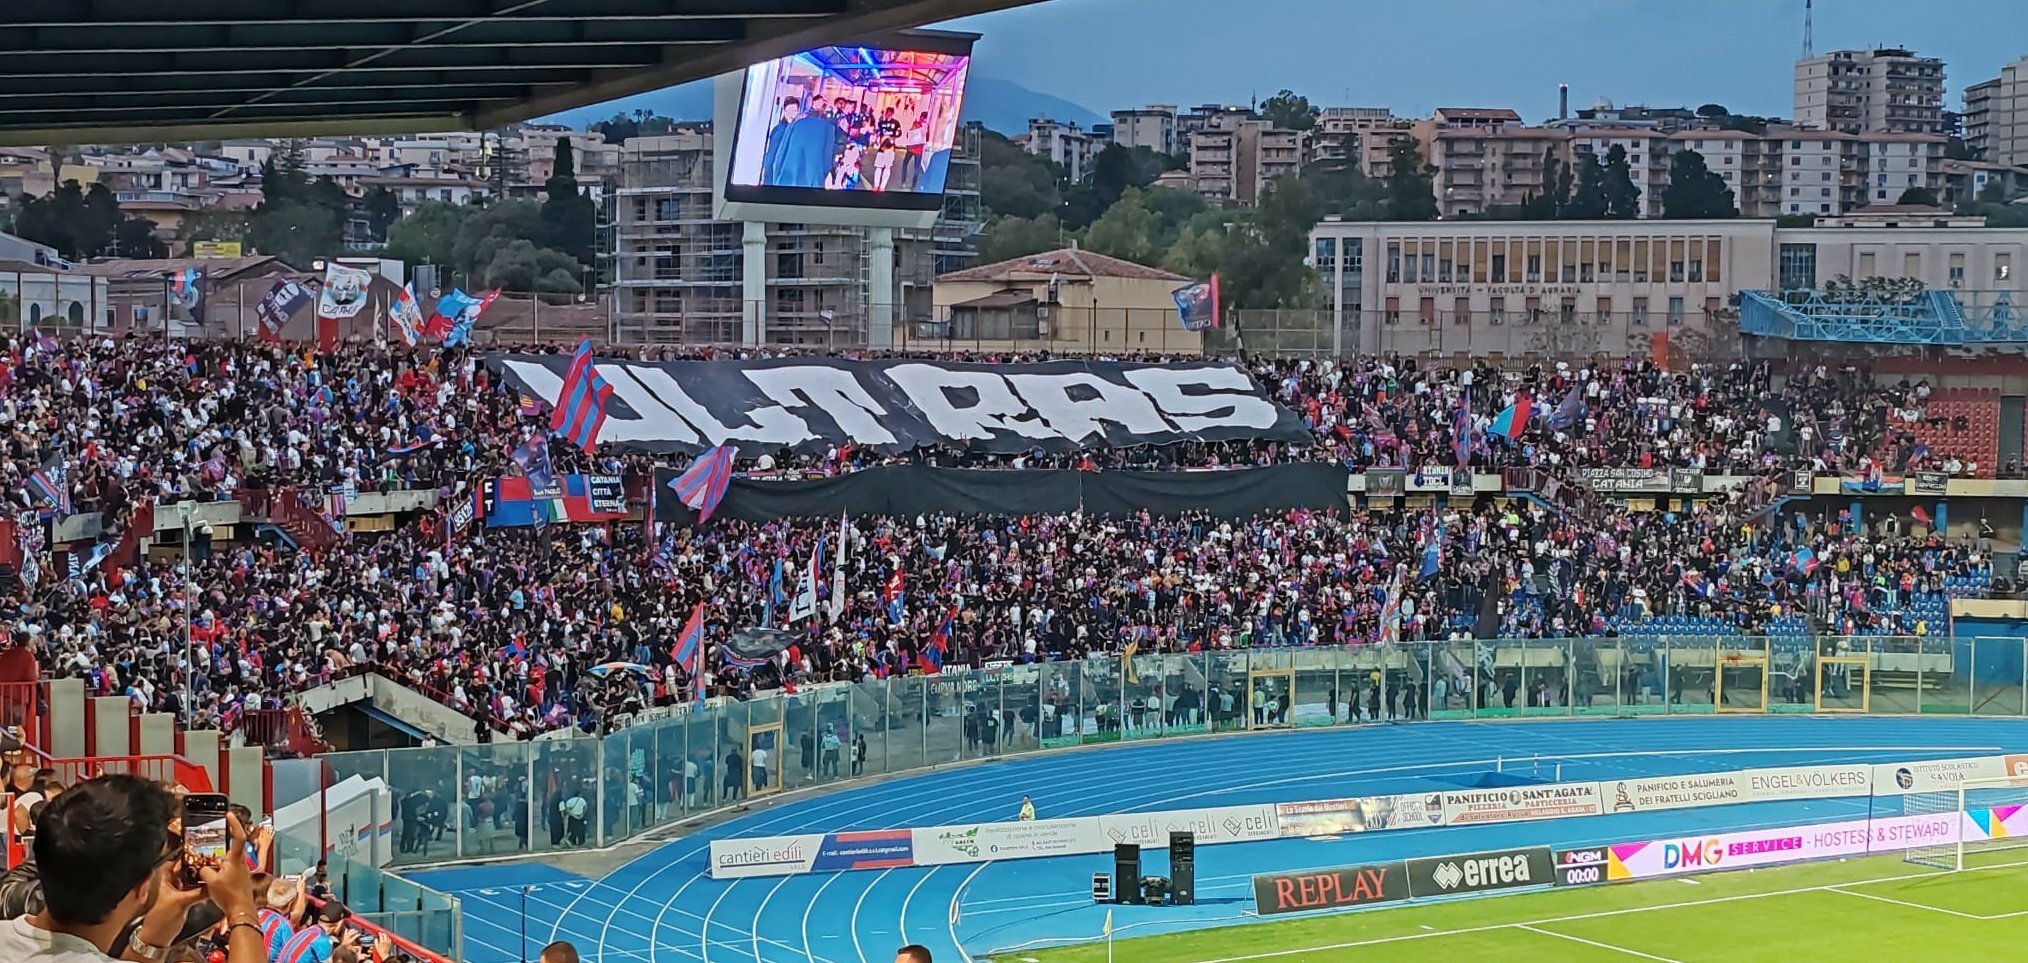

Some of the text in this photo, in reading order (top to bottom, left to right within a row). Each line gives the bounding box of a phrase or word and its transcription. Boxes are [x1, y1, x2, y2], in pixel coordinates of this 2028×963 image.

[503, 361, 1279, 447] ULTRAS
[590, 476, 620, 484] CATANIA
[1592, 479, 1644, 488] CATANIA
[592, 486, 612, 496] CITTÀ
[941, 663, 973, 677] ATANIA
[1930, 772, 1966, 782] SAVOIA
[1637, 778, 1734, 792] PANIFICIO E SALUMERIA
[1447, 792, 1508, 804] PANIFICIO
[1468, 798, 1578, 812] PIZZERIA PASTICCERIA
[1639, 789, 1738, 806] DEI FRATELLI SCIGLIANO
[1246, 809, 1272, 830] celi
[1132, 817, 1158, 839] celi
[1664, 838, 1723, 870] DMG
[1731, 837, 1801, 855] SERVICE
[1814, 828, 1875, 848] HOSTESS
[1877, 828, 1886, 842] &
[1888, 821, 1949, 841] STEWARD
[720, 844, 802, 864] cantieri edili
[1567, 868, 1599, 884] 00:00
[1275, 868, 1388, 909] REPLAY
